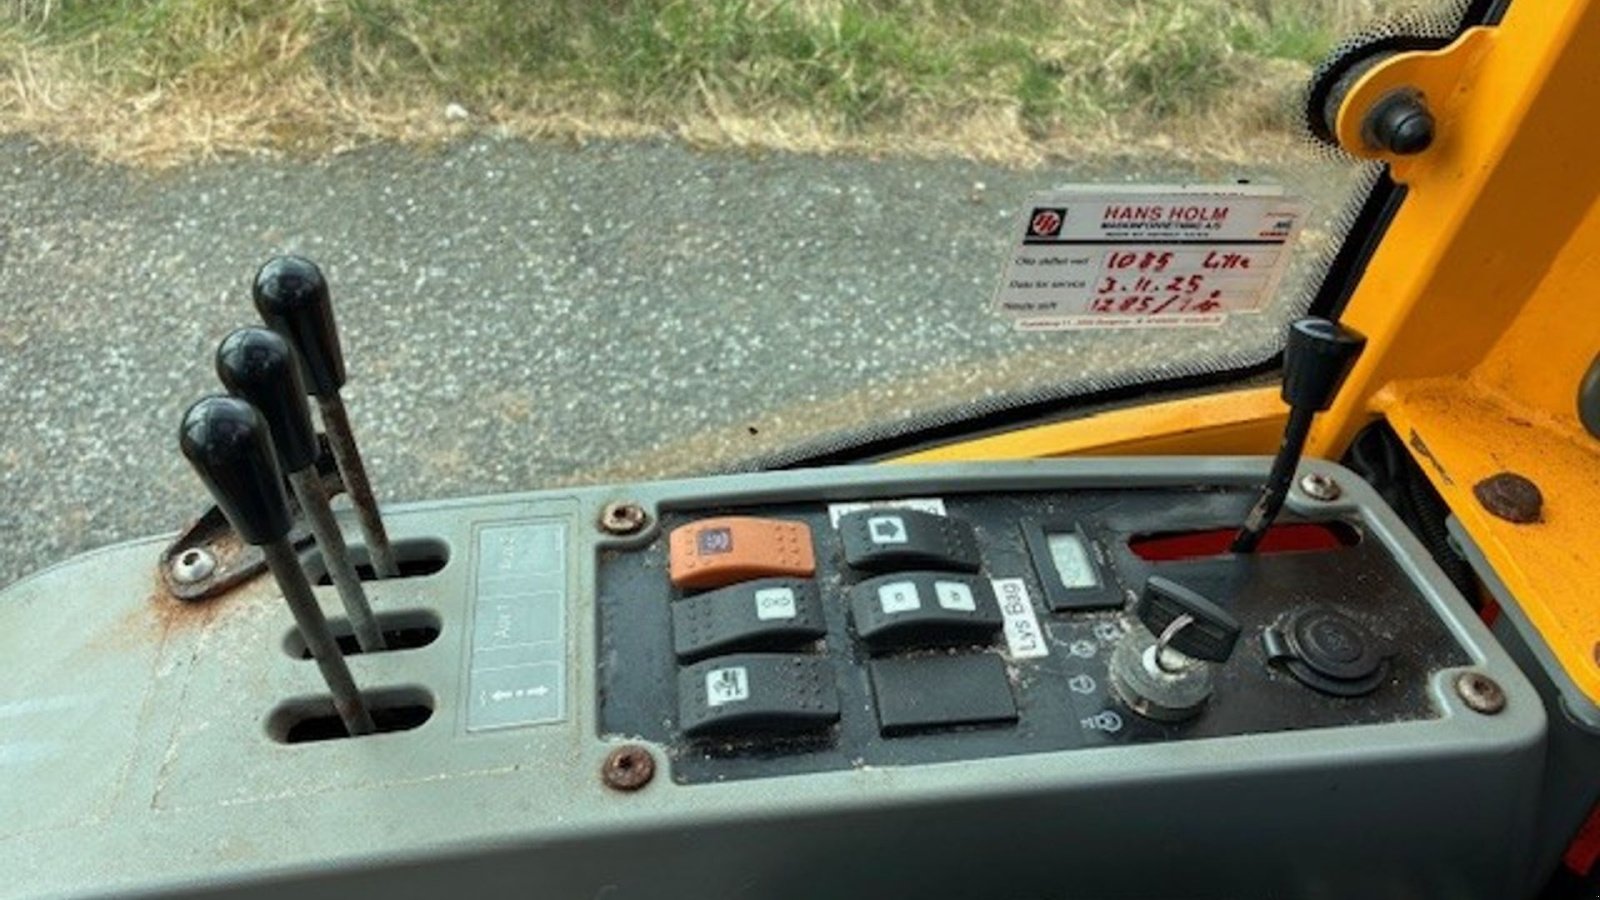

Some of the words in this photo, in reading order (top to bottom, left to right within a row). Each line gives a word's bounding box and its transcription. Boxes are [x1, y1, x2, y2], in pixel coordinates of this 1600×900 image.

[1103, 205, 1164, 220] HANS
[1168, 205, 1230, 220] HOLM
[1002, 582, 1024, 616] Bag
[1013, 619, 1037, 651] Lys
